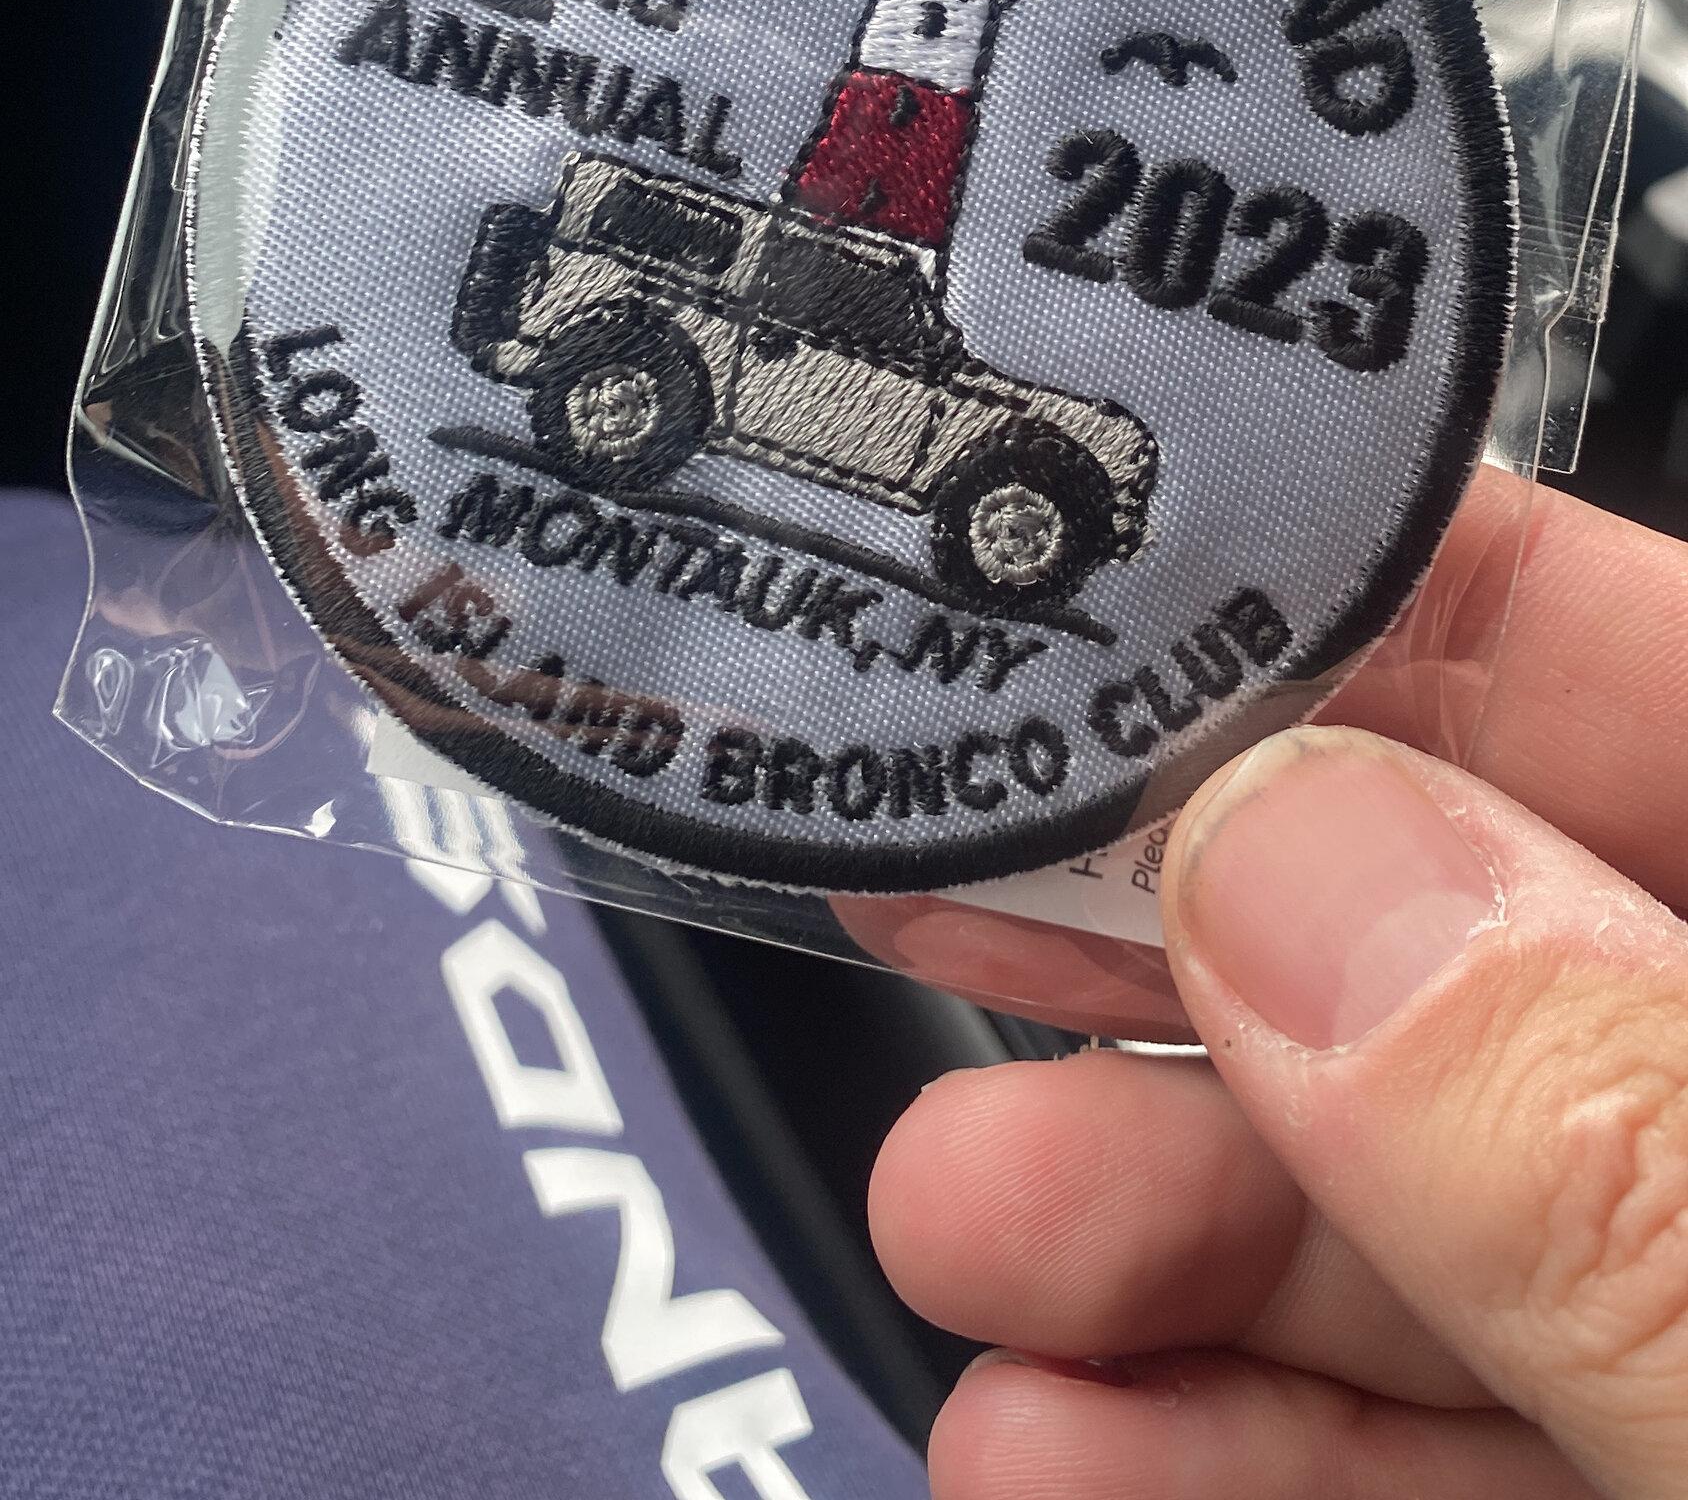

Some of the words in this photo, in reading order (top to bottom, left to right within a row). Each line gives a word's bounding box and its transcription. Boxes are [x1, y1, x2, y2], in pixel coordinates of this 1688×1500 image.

[1022, 127, 1432, 373] 2023
[259, 323, 418, 558] LONG
[399, 560, 685, 777] ISLAND
[699, 714, 1071, 821] BRONCO
[1086, 585, 1293, 757] CLUB
[899, 612, 1050, 693] NY
